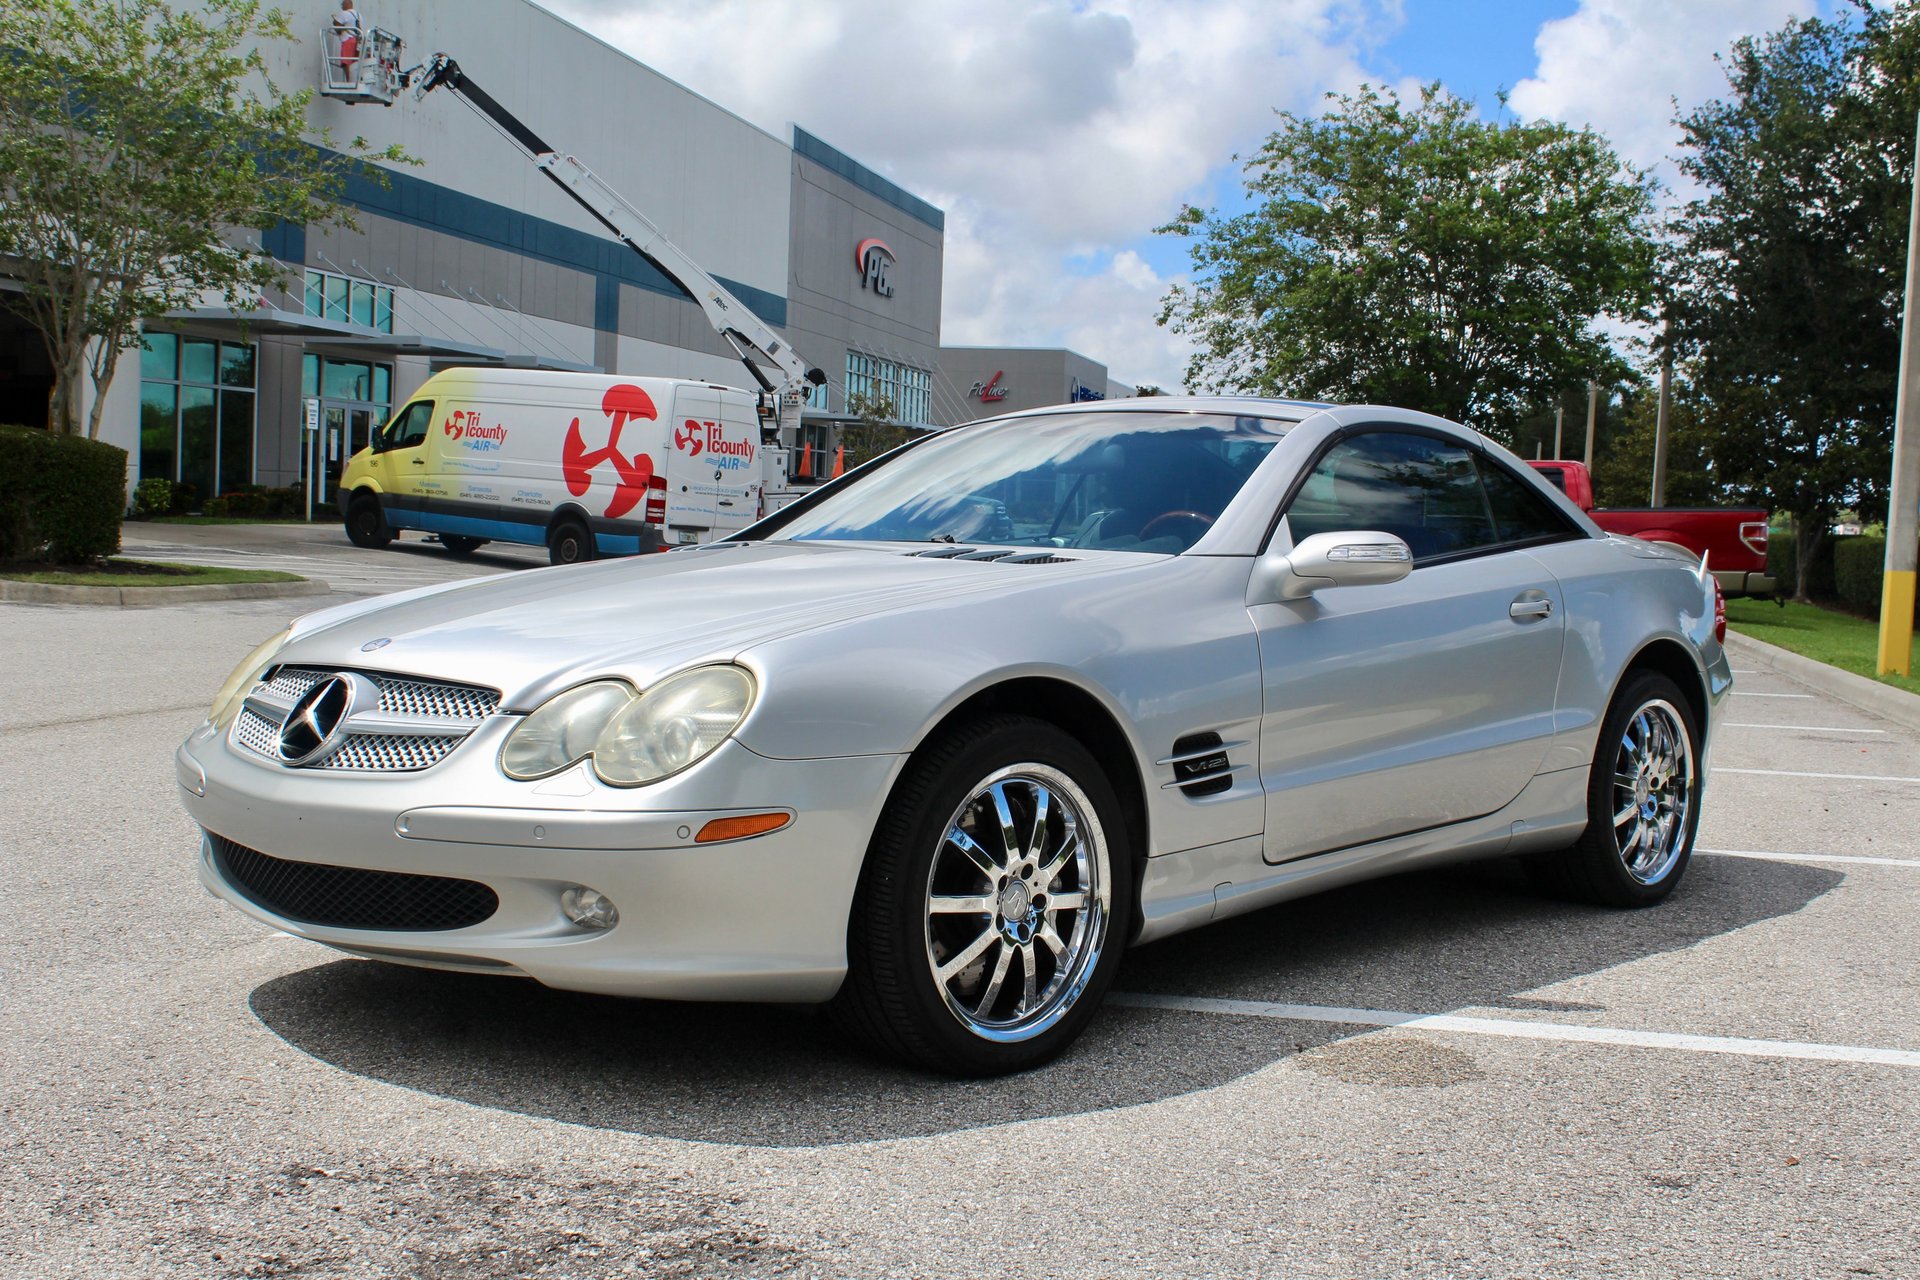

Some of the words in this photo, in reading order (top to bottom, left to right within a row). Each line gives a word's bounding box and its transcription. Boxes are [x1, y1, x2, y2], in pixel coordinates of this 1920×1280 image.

[466, 411, 481, 437] Tri
[703, 421, 723, 453] Tri
[472, 440, 491, 451] AIR
[718, 456, 740, 471] AIR
[750, 484, 758, 492] 196
[1185, 757, 1226, 772] V12
